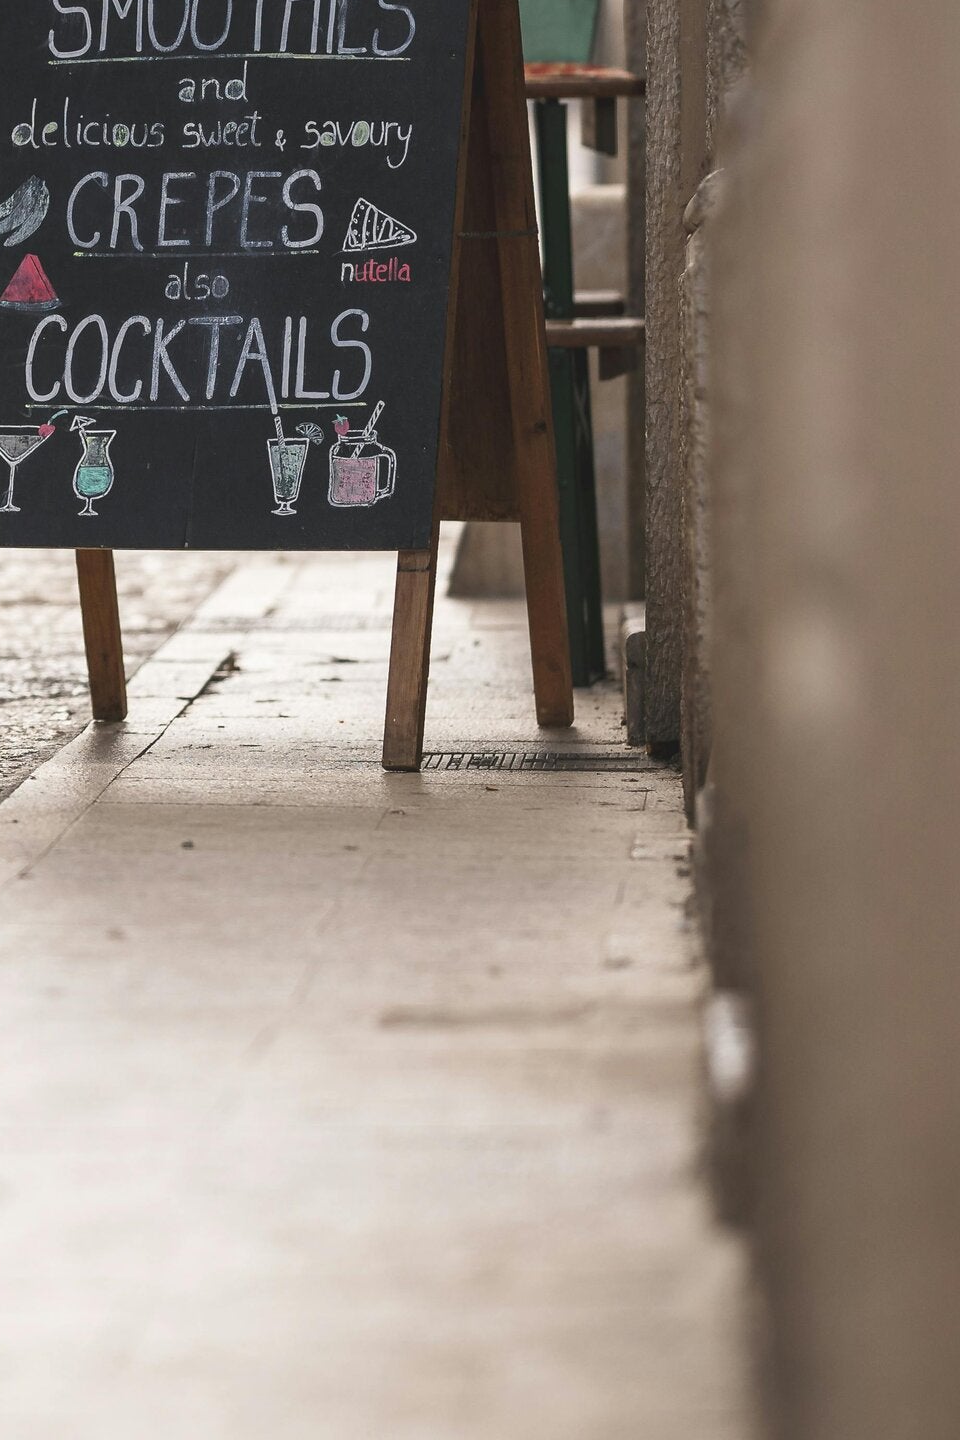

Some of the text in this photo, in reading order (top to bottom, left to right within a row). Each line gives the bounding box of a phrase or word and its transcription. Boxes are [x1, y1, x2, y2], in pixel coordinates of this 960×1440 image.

[178, 60, 248, 102] and
[12, 97, 413, 169] delicious sweet & savoury
[66, 169, 324, 251] CREPES
[164, 262, 230, 300] also
[340, 257, 411, 282] nutella
[25, 309, 372, 414] COCKTAILS
